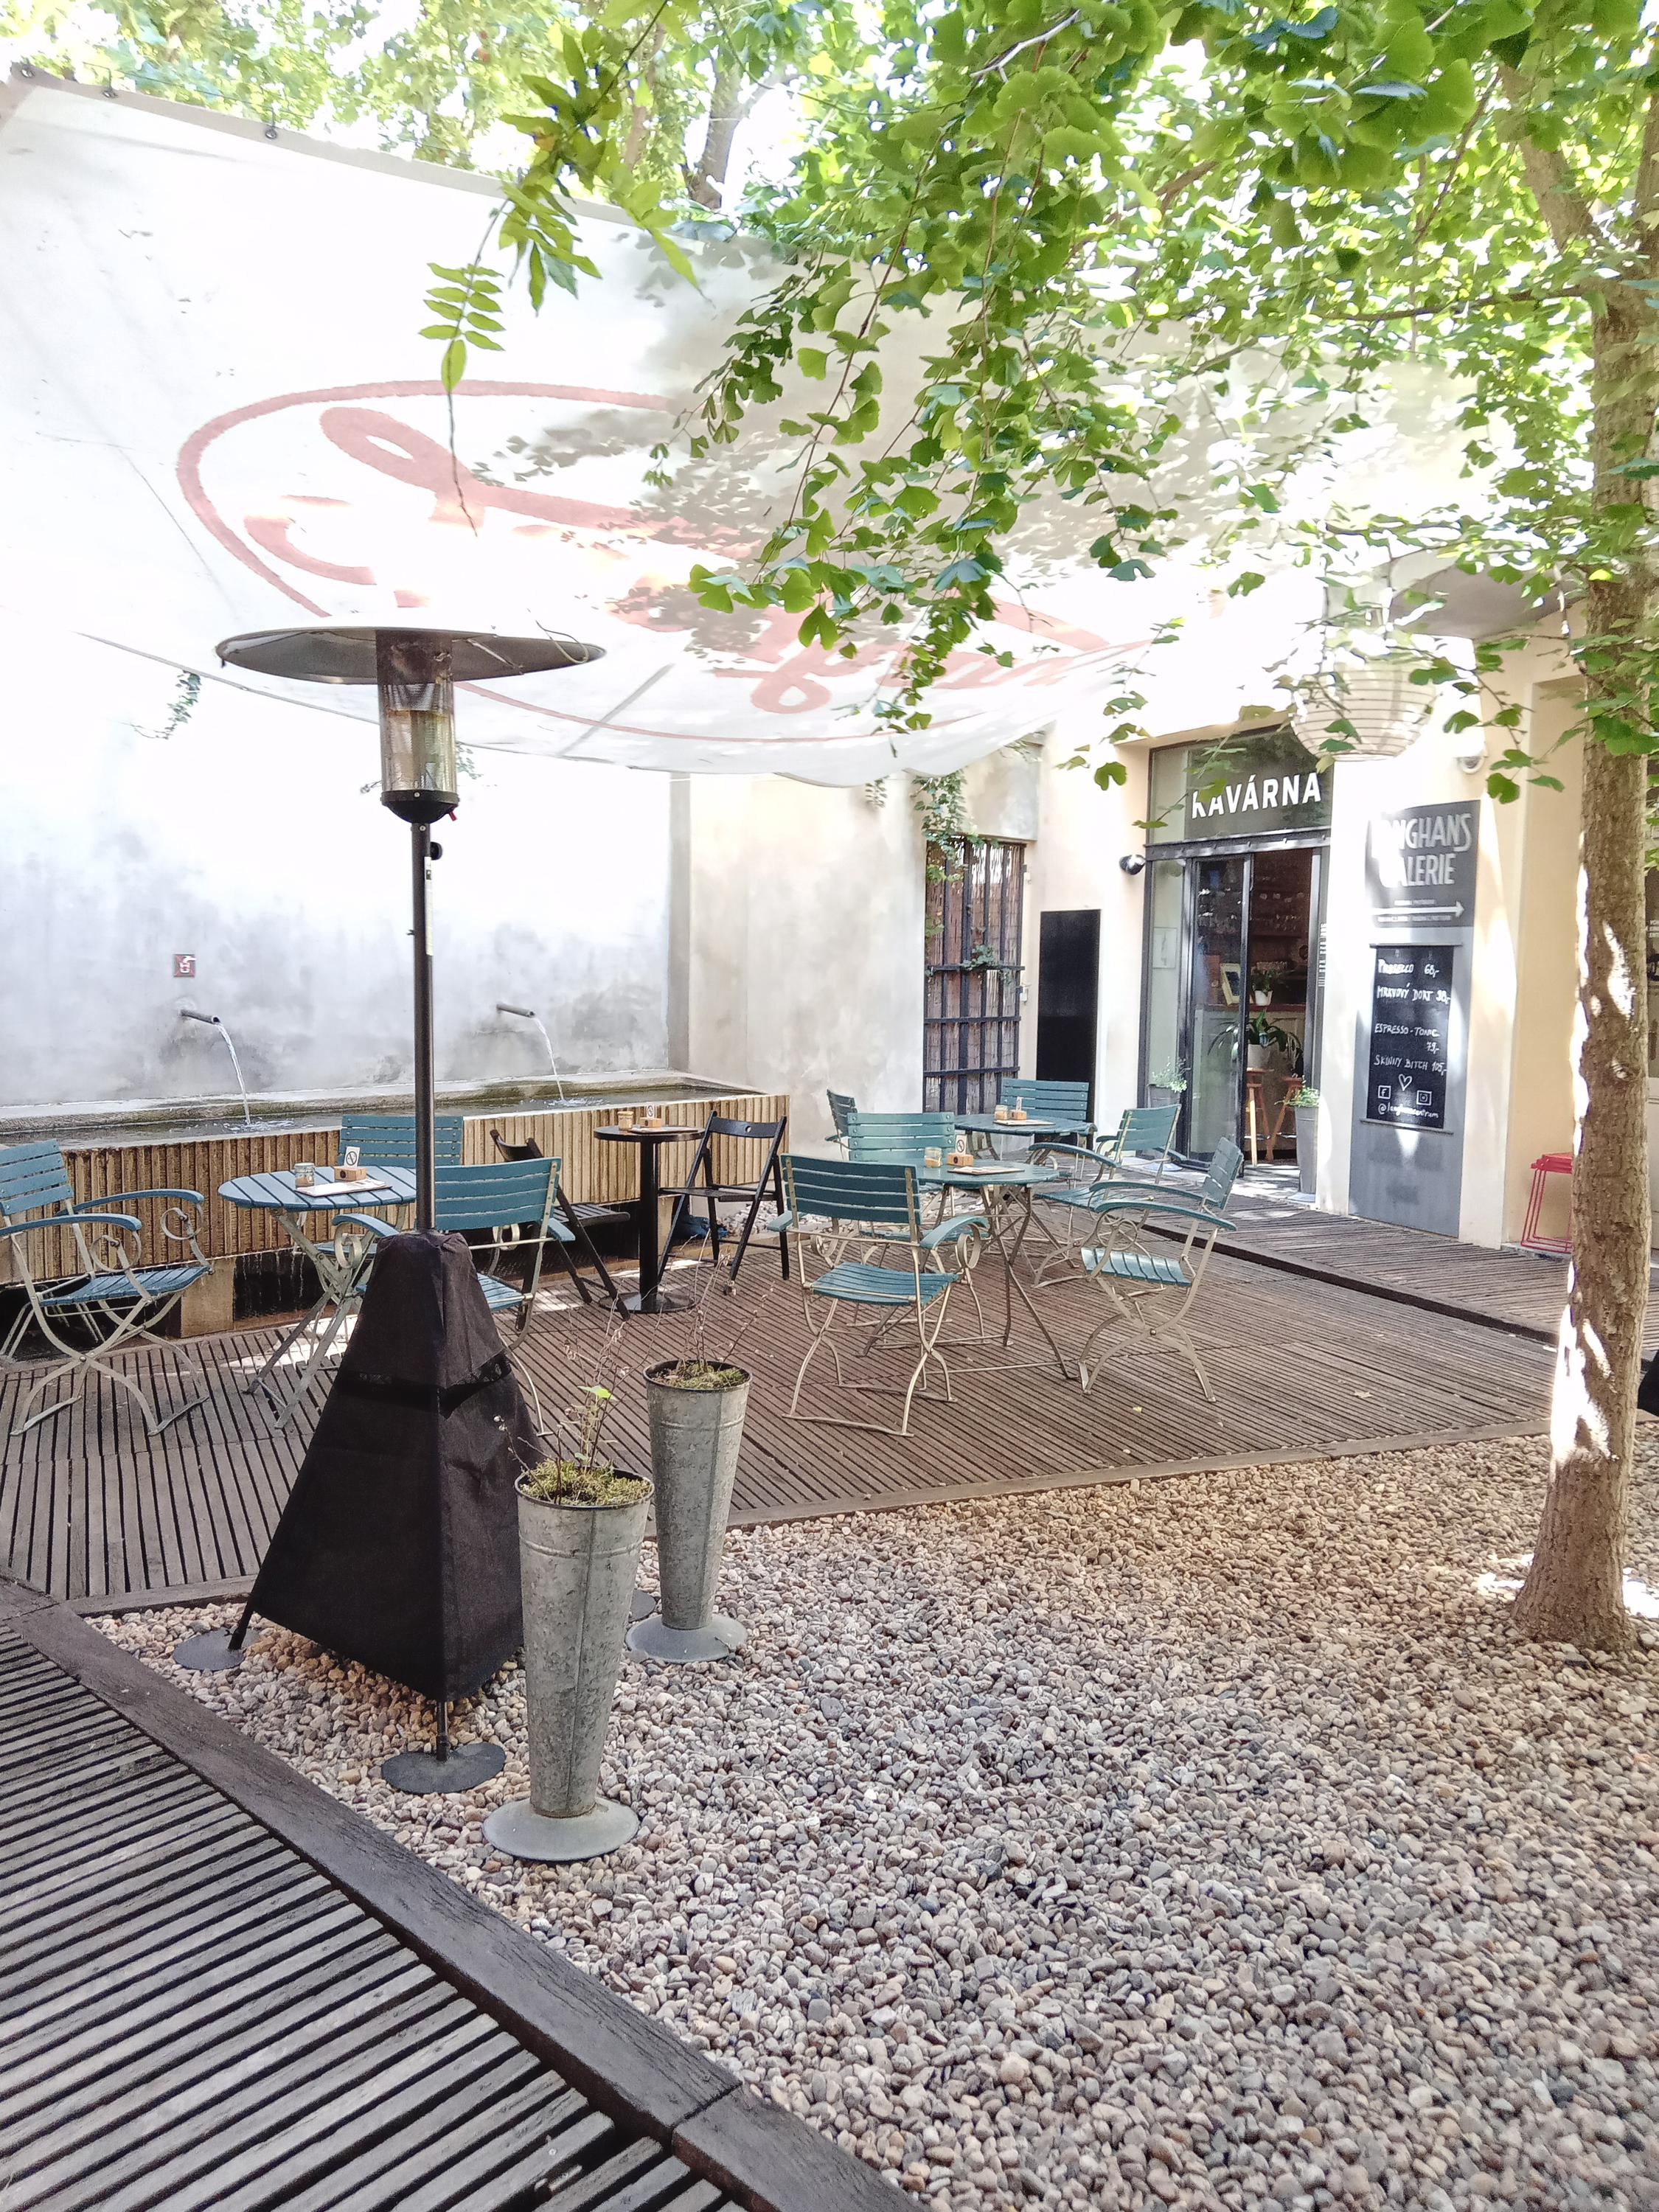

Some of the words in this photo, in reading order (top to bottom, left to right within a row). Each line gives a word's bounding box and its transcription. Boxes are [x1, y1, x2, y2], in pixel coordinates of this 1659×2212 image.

[1192, 772, 1321, 819] KAVÁRNA
[1371, 813, 1472, 858] NGHANS
[1379, 853, 1457, 888] ALERIE
[1411, 989, 1433, 1001] DORT
[1404, 1058, 1428, 1071] BITCH
